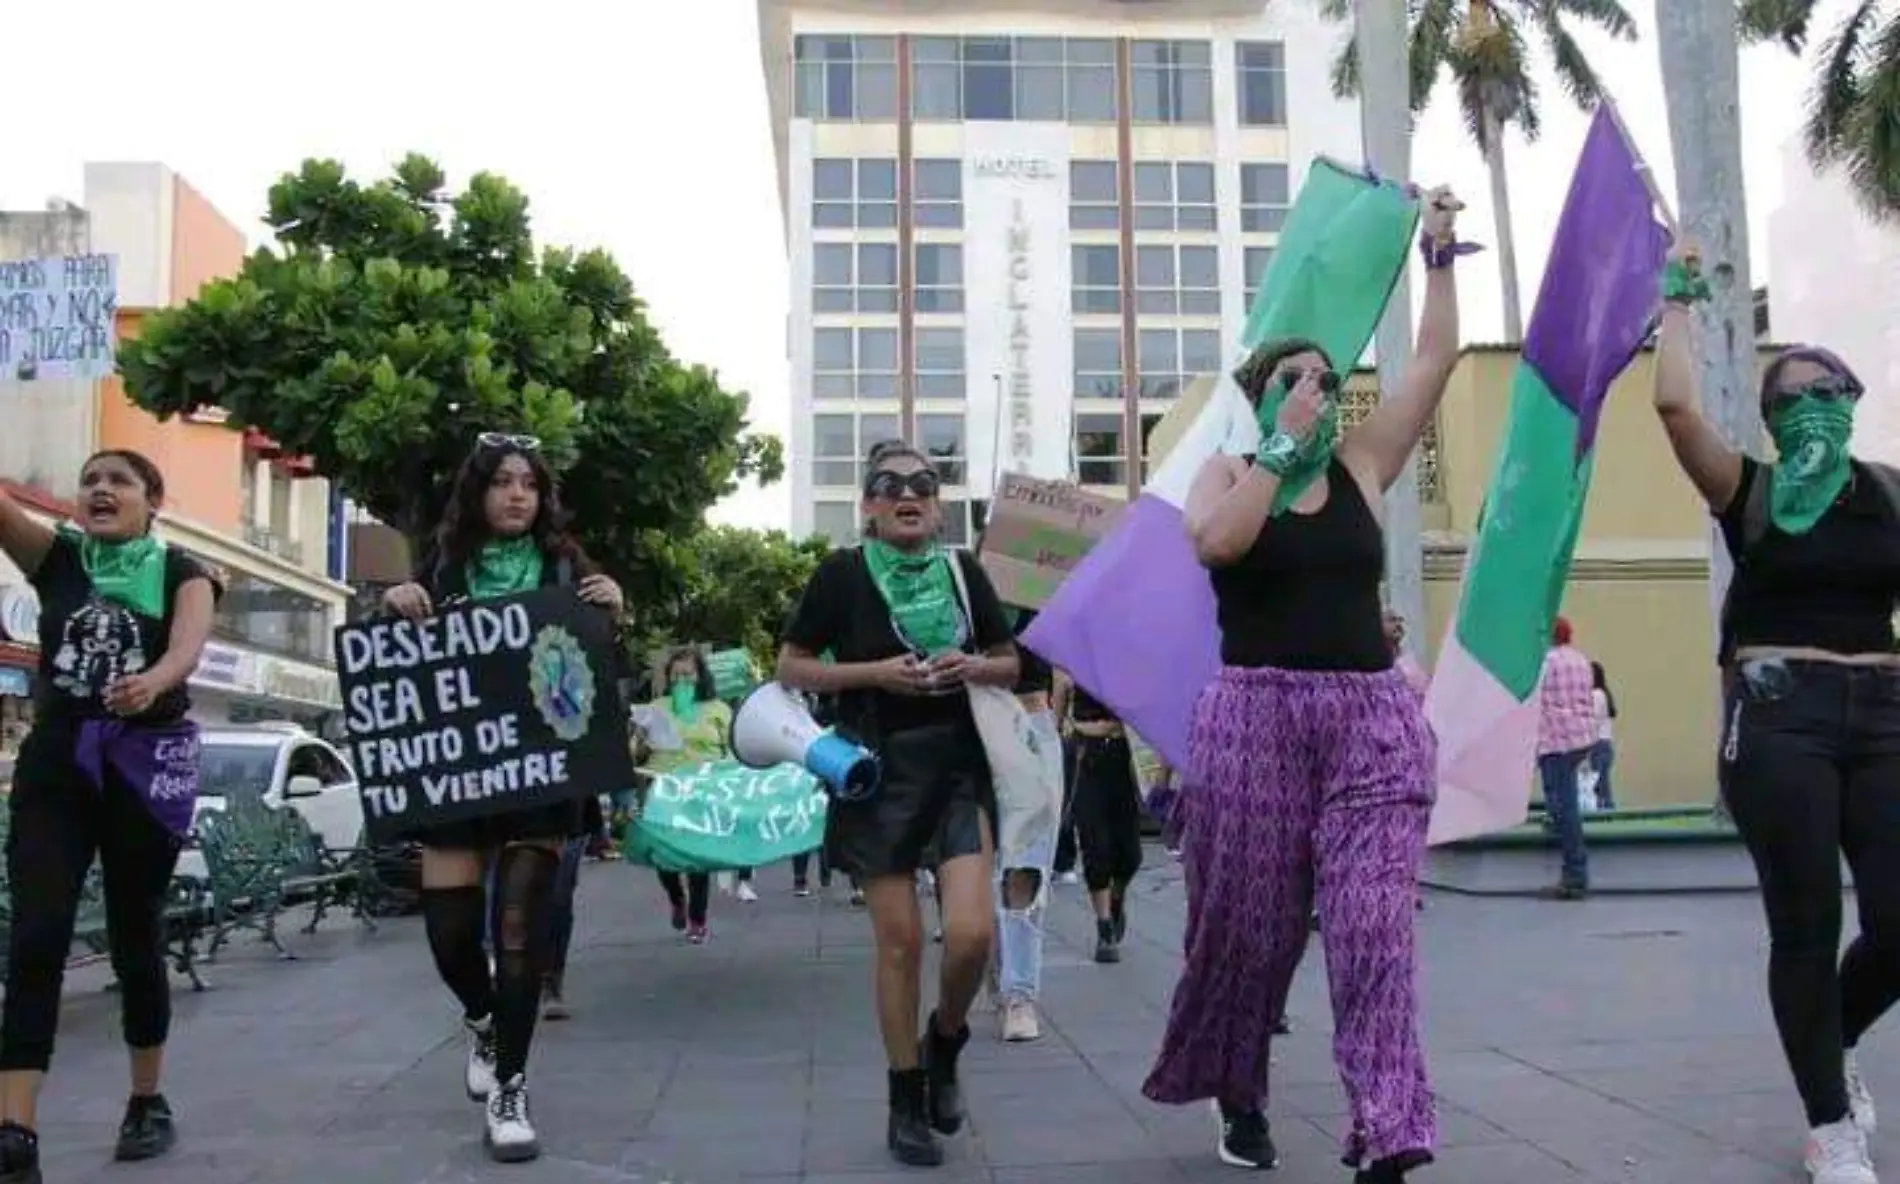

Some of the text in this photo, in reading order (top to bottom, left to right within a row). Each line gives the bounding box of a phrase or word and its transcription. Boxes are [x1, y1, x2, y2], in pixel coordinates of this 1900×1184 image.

[341, 603, 530, 673] DESEADO
[349, 667, 480, 733] SEA EL
[358, 714, 520, 777] FRUTO DE
[363, 750, 570, 818] TU VIENTRE
